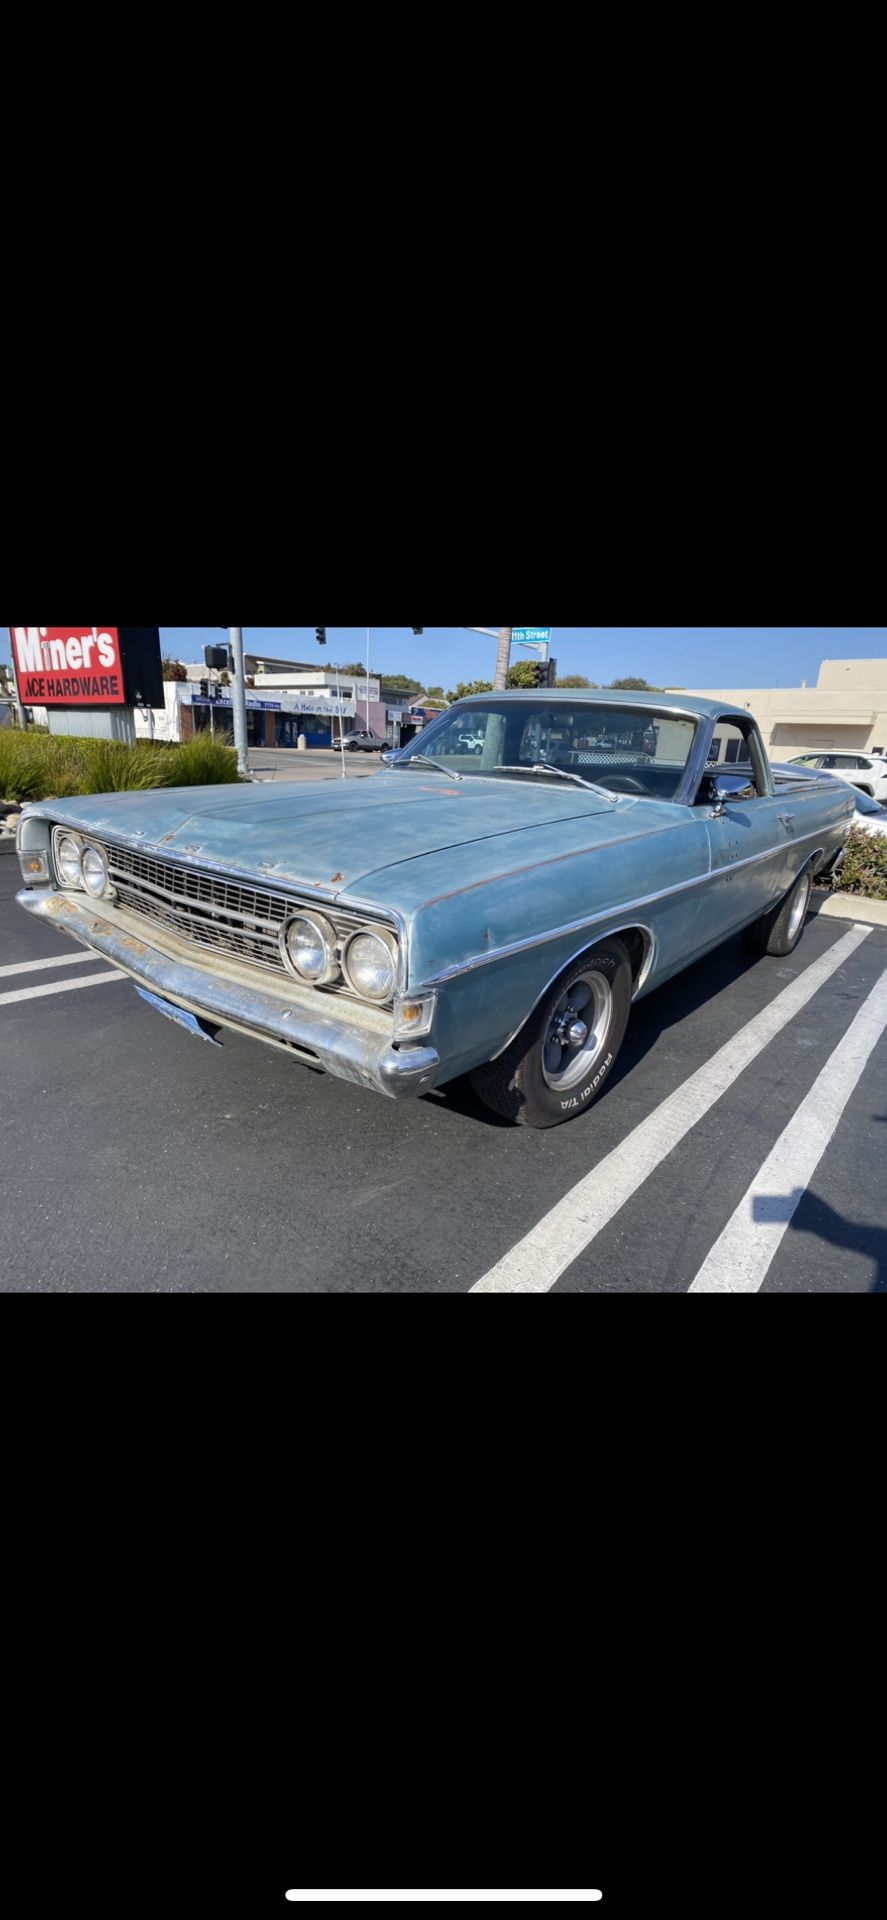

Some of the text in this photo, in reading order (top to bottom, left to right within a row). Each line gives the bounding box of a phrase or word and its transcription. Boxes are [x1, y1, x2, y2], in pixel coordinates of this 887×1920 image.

[14, 627, 115, 672] Miner's
[525, 630, 548, 640] Street
[26, 675, 119, 697] ACE HARDWARE
[560, 1053, 613, 1109] Radial T/A
